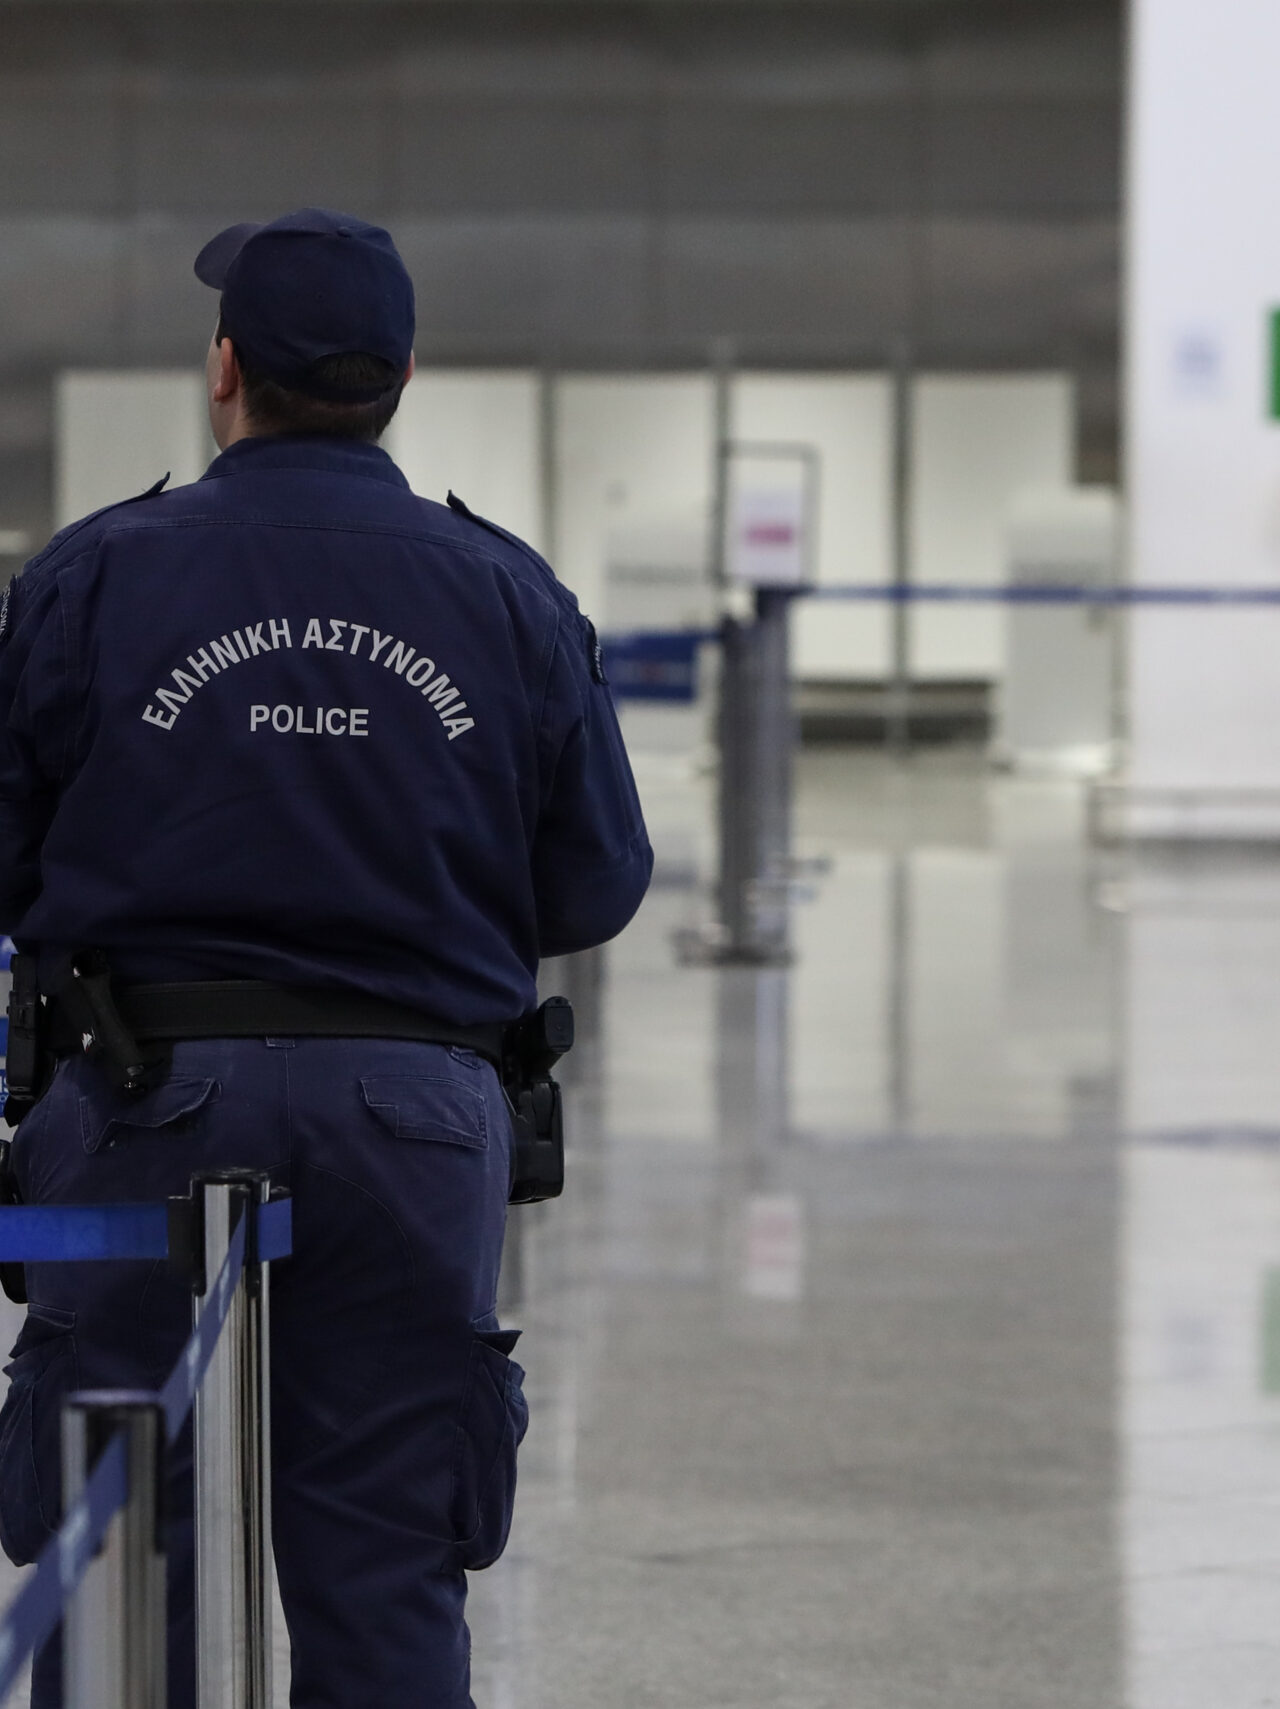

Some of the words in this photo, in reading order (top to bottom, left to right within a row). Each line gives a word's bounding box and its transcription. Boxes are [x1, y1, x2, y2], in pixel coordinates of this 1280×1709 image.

[142, 618, 293, 730] ΕΛΛΗΝΙΚΗ
[301, 618, 475, 741] ΑΣΤΥΝΟΜΙΑ
[250, 704, 369, 736] POLICE
